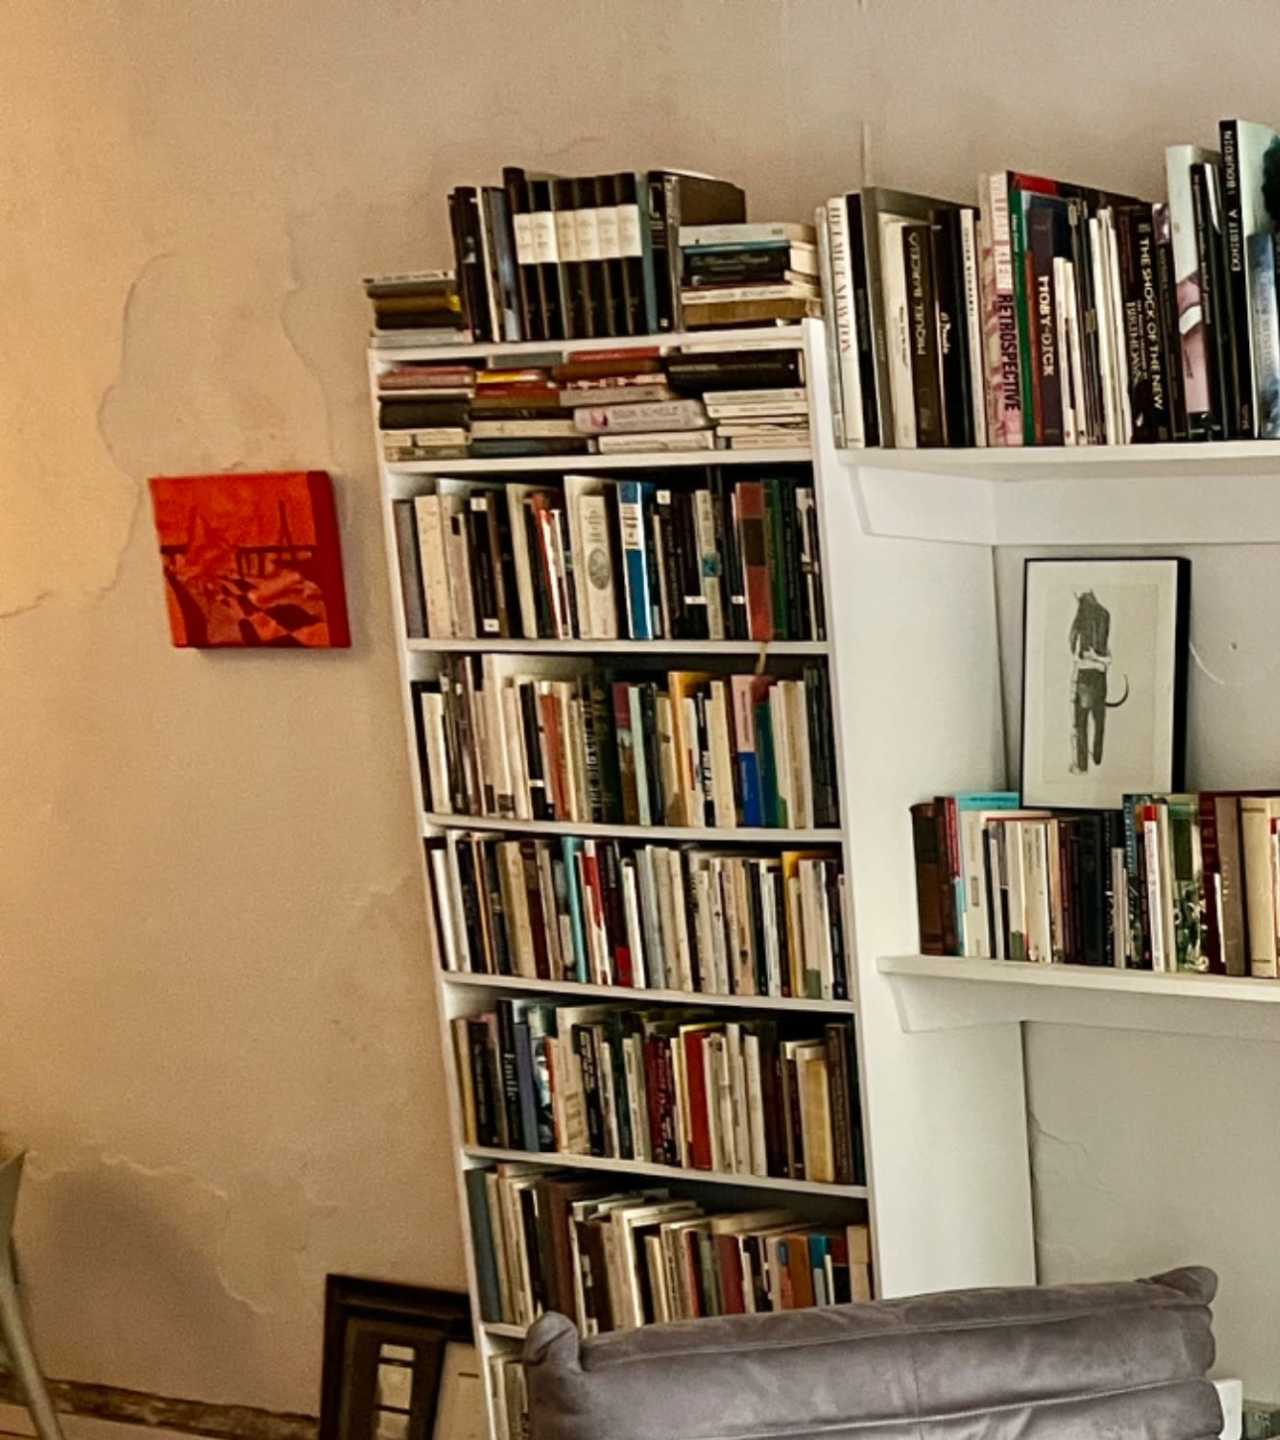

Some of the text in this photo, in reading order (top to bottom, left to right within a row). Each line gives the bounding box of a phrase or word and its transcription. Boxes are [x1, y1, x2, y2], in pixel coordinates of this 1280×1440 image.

[997, 294, 1021, 413] RETROSPECTIVE
[1037, 276, 1054, 376] MOBY-DICK
[1139, 237, 1164, 410] THE SHOCK OF THE NEW
